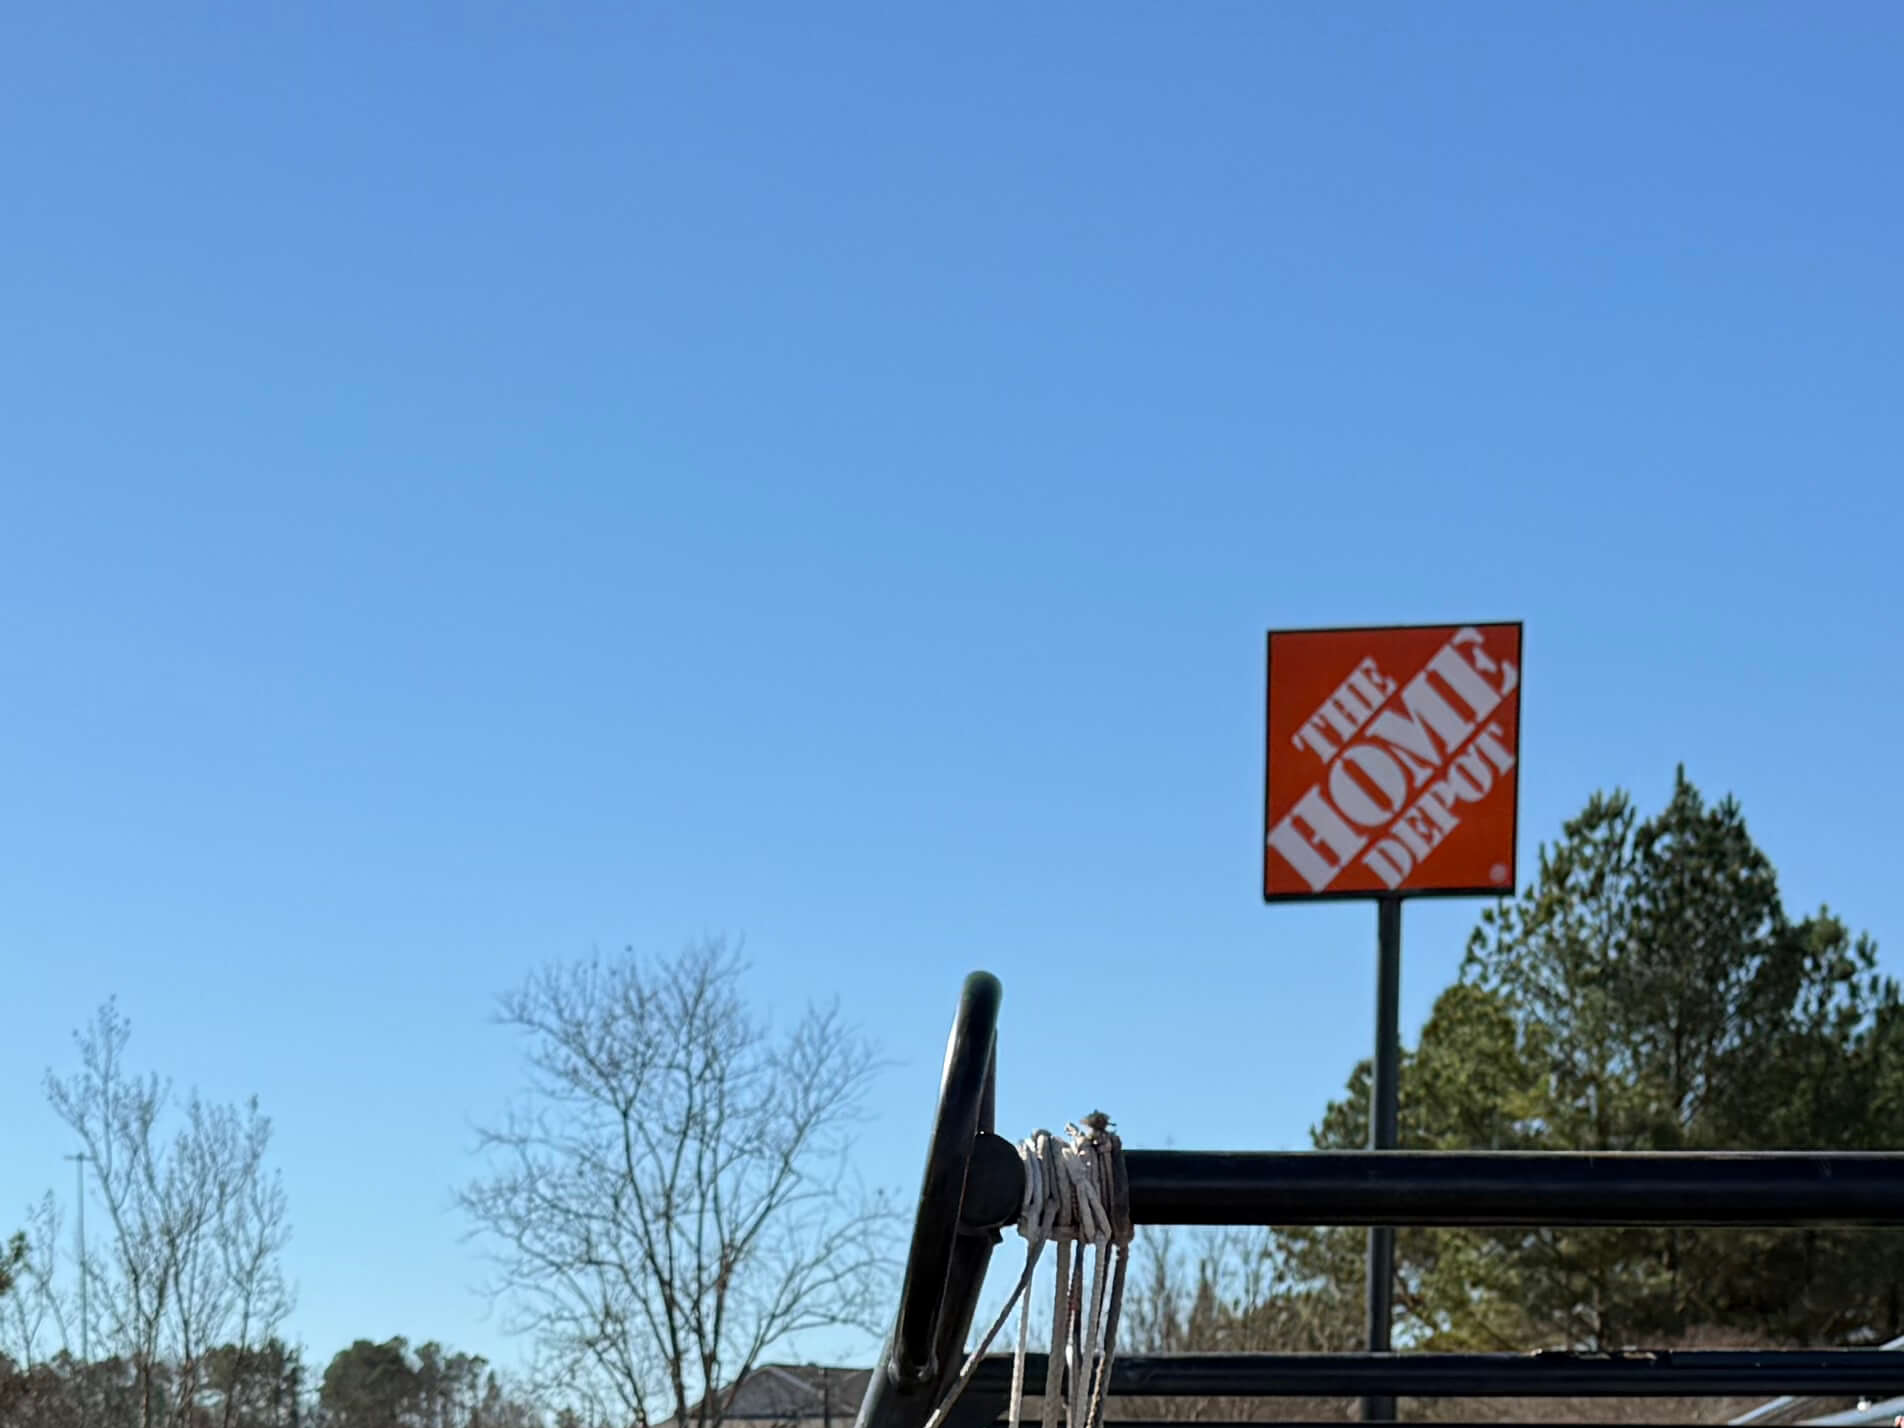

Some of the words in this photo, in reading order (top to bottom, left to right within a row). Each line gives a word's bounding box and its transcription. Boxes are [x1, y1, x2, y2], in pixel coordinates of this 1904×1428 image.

[1267, 626, 1518, 892] HOME
[1291, 656, 1396, 765] THE
[1362, 722, 1515, 891] DEPOT
